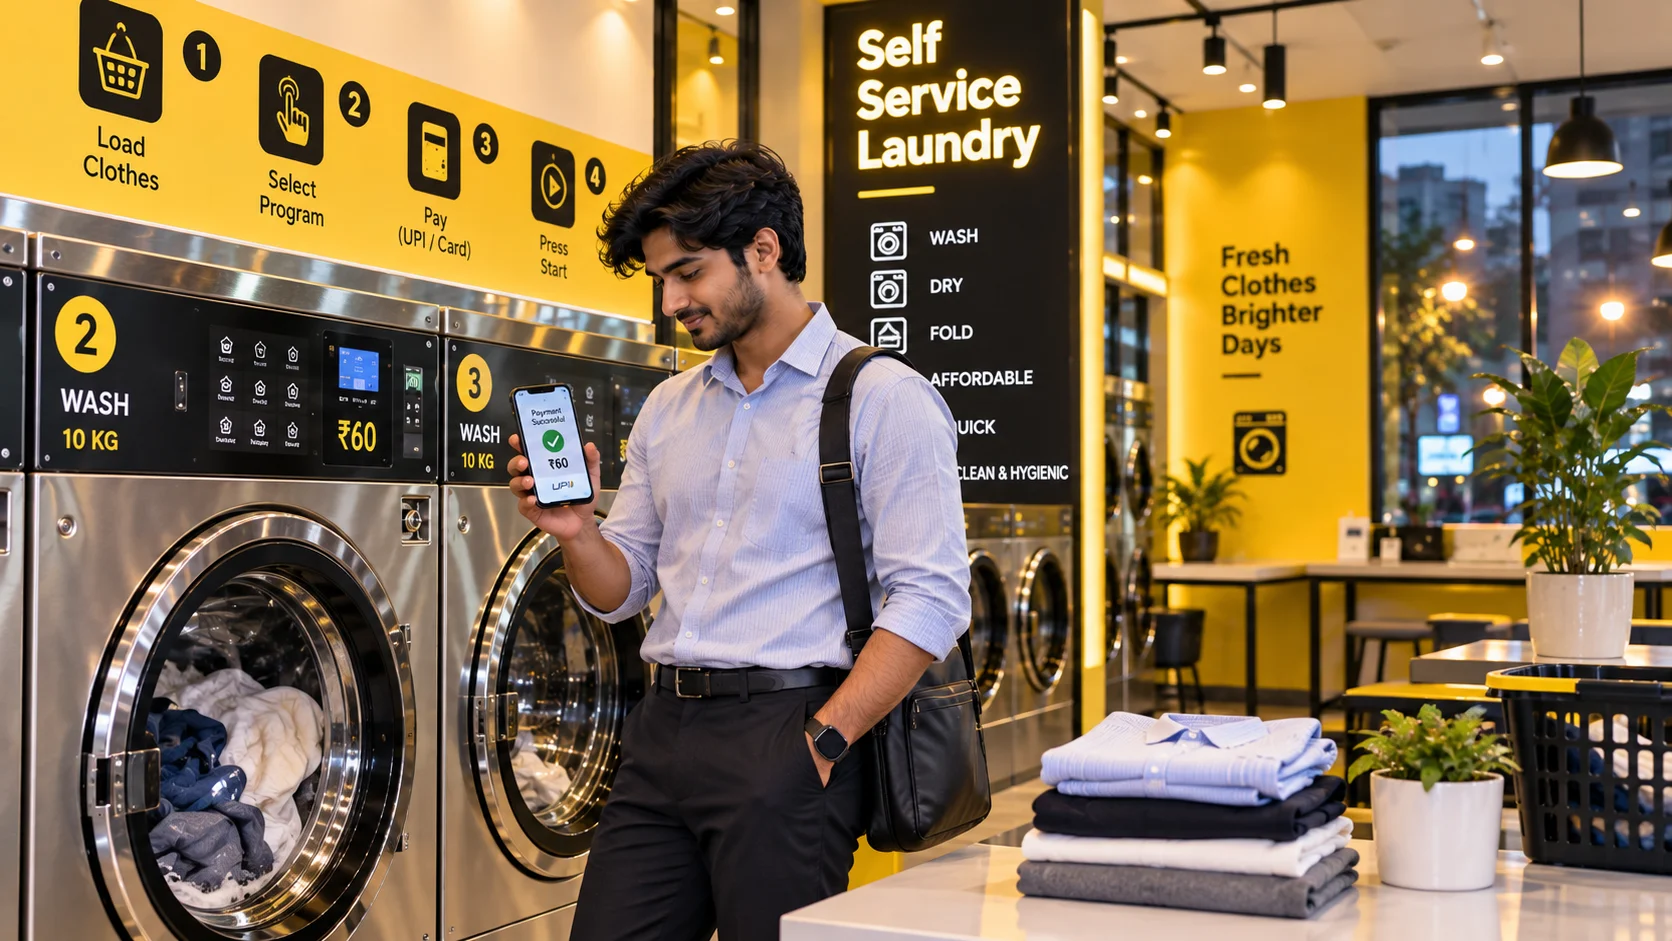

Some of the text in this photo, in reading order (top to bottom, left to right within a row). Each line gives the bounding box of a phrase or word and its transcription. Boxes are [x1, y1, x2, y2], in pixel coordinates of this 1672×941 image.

[196, 43, 207, 71] 1
[857, 20, 943, 71] Self
[348, 91, 361, 118] 2
[857, 68, 1022, 121] Service
[98, 126, 145, 157] Load
[480, 131, 491, 156] 3
[858, 118, 1041, 170] Laundry
[83, 155, 159, 191] Clothes
[269, 170, 316, 198] Select
[590, 166, 600, 188] 4
[260, 195, 324, 227] Program
[424, 207, 447, 231] Pay
[399, 226, 471, 261] (UPI / Card)
[540, 235, 568, 256] Press
[930, 228, 979, 246] WASH
[1222, 242, 1290, 268] Fresh
[541, 259, 567, 279] Start
[930, 278, 963, 294] DRY
[1222, 273, 1316, 297] Clothes
[1222, 302, 1323, 330] Brighter
[74, 313, 97, 356] 2
[930, 325, 973, 341] FOLD
[1222, 333, 1282, 360] Days
[468, 367, 481, 399] 3
[930, 370, 1033, 387] AFFORDABLE
[61, 388, 129, 416] WASH
[62, 428, 119, 451] 10 KG
[338, 419, 377, 452] ₹60
[460, 423, 500, 444] WASH
[957, 419, 996, 435] UICK
[461, 453, 494, 469] 10 KG
[548, 457, 569, 470] ₹60
[998, 466, 1008, 480] &
[1010, 465, 1069, 480] HYGIENIC
